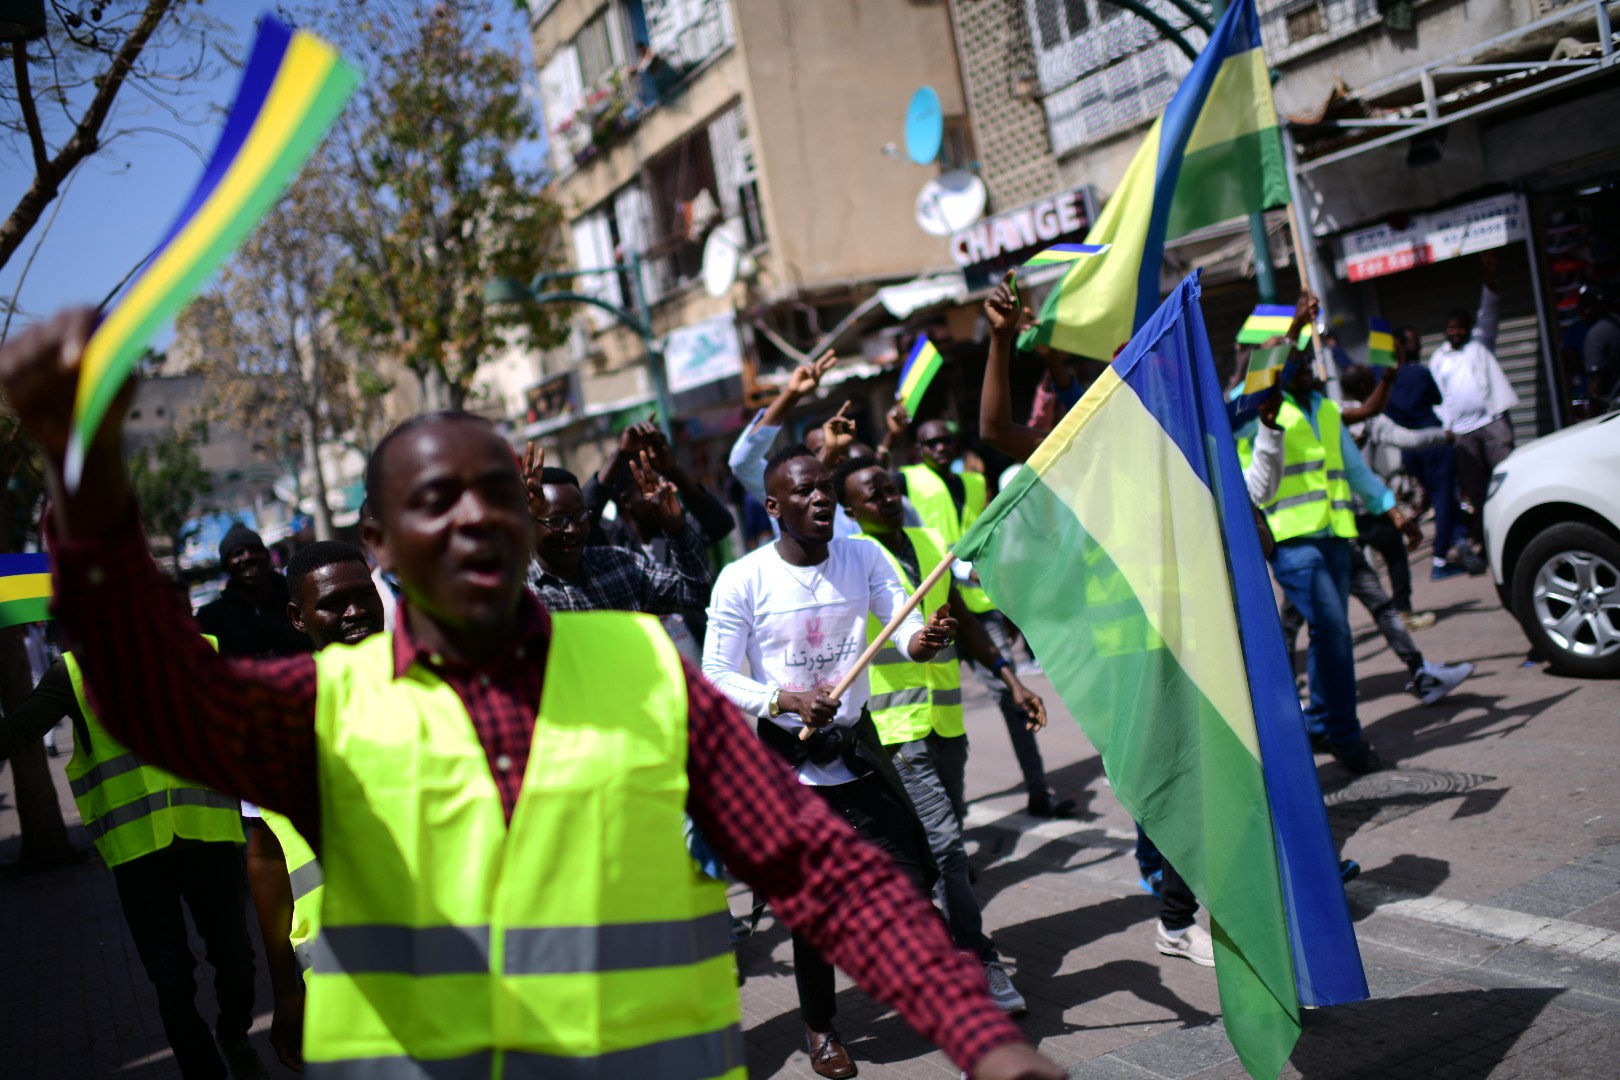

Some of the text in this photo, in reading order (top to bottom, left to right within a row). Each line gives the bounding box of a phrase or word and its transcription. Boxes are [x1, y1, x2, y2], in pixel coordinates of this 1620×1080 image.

[951, 191, 1085, 267] CHANGE
[1356, 260, 1385, 278] For
[784, 636, 858, 671] #ثورتنا
